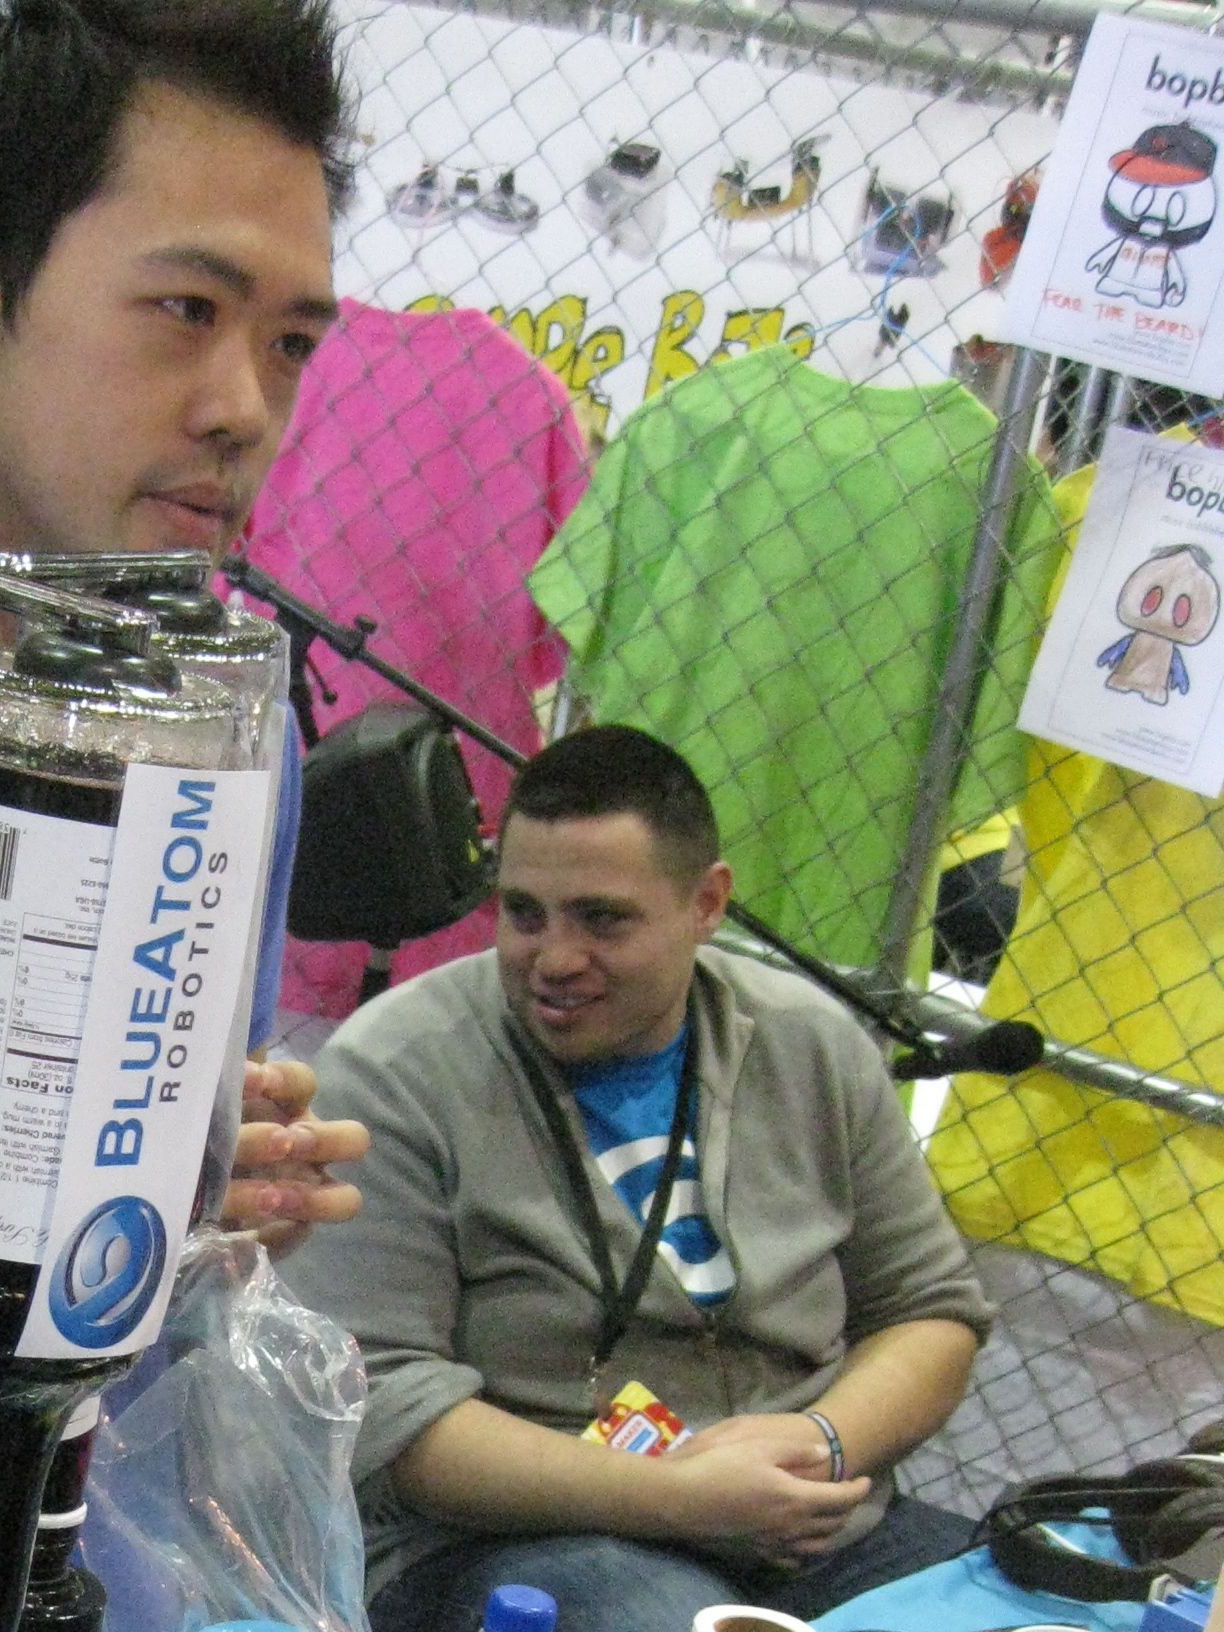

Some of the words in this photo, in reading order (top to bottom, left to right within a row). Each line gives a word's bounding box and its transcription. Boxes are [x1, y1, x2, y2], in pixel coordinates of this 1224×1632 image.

[5, 1075, 49, 1094] Facts
[95, 779, 217, 1167] BLUEATOM
[158, 851, 229, 1103] ROBOTICS
